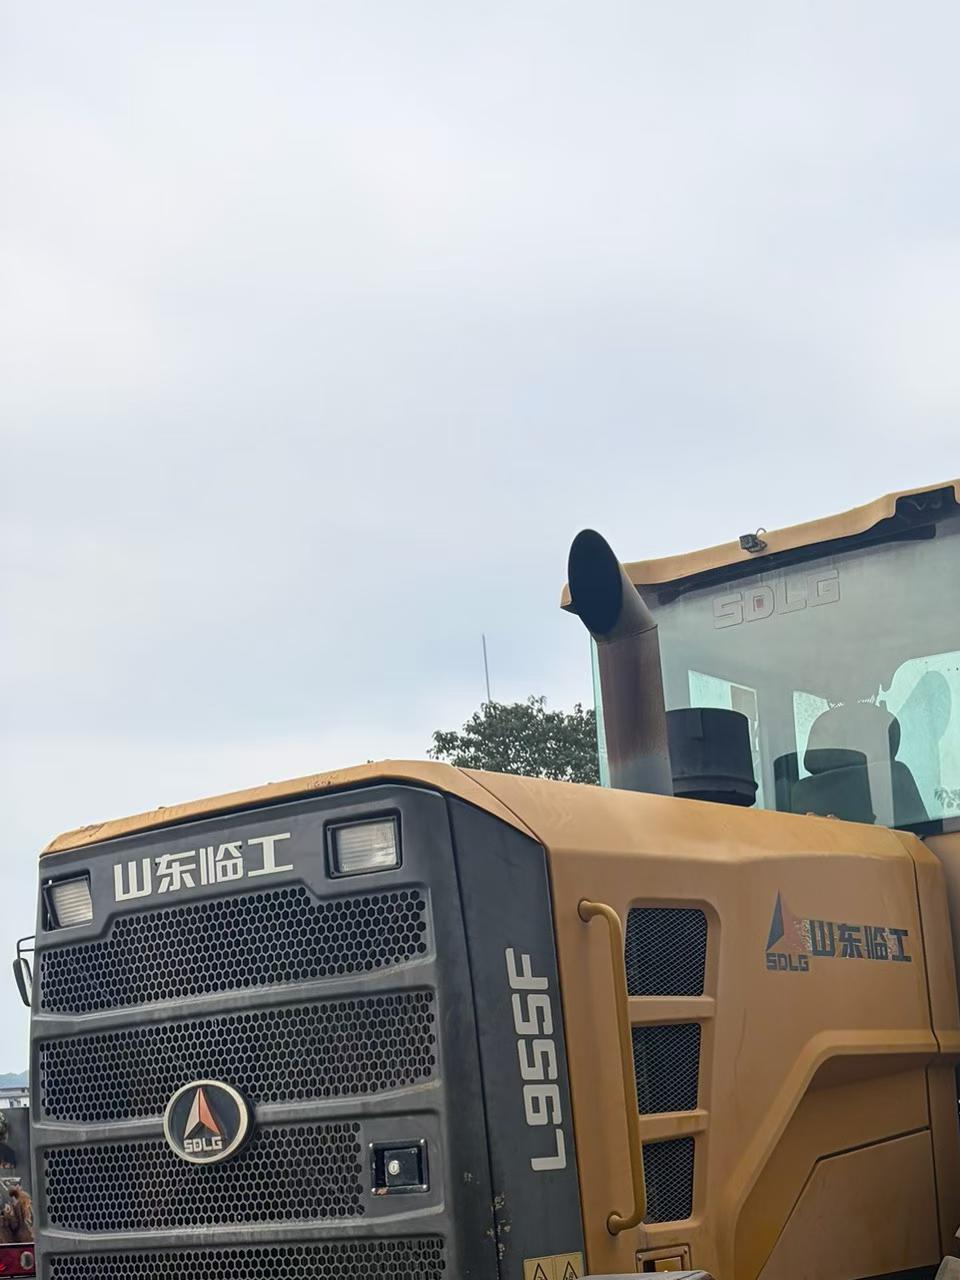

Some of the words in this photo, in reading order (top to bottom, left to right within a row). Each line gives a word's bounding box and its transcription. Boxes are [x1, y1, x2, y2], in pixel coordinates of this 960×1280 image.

[712, 568, 841, 630] SDLG
[113, 832, 294, 902] 山东临工
[765, 952, 809, 972] SDLG
[808, 919, 913, 963] 山东临工
[505, 947, 567, 1171] L955F
[183, 1136, 223, 1153] SDLG
